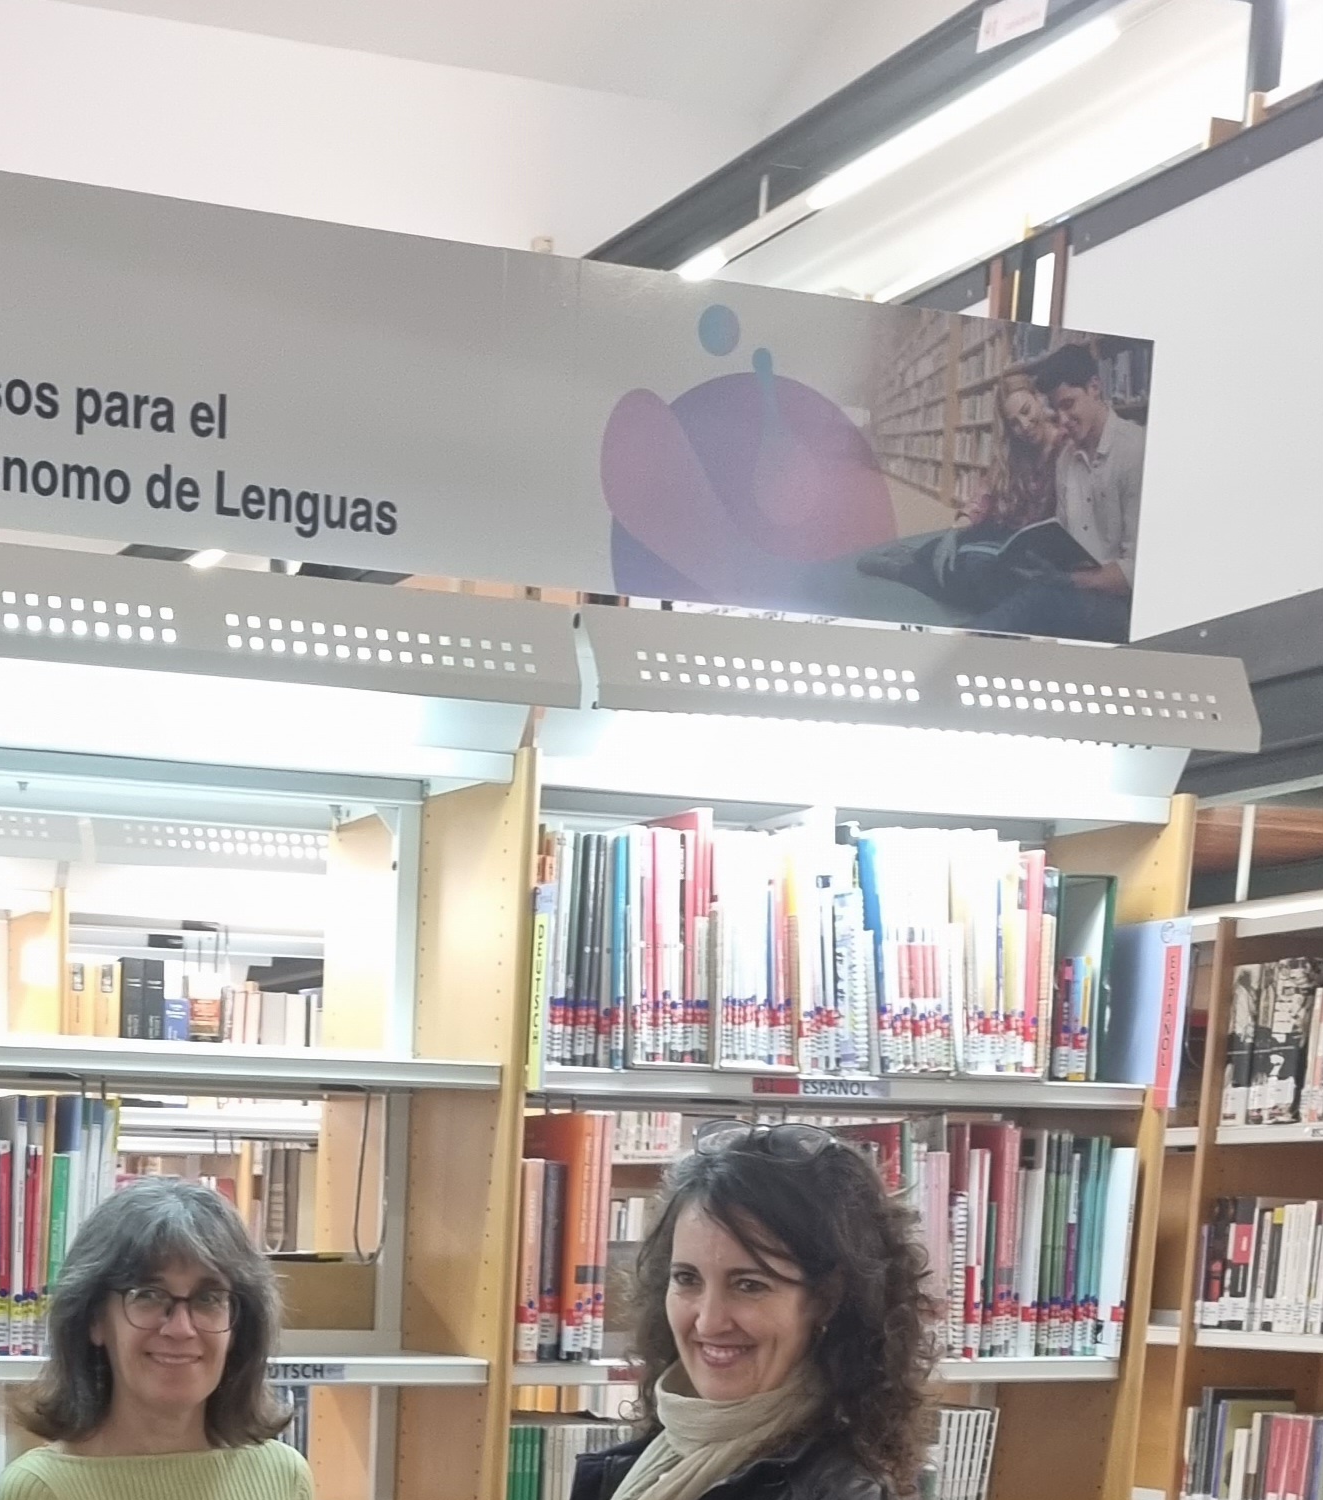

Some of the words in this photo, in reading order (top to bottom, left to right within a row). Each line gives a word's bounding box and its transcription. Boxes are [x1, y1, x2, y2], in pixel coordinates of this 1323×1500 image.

[76, 384, 175, 434] para
[190, 393, 228, 439] el
[145, 462, 200, 511] de
[216, 469, 399, 538] Lenguas
